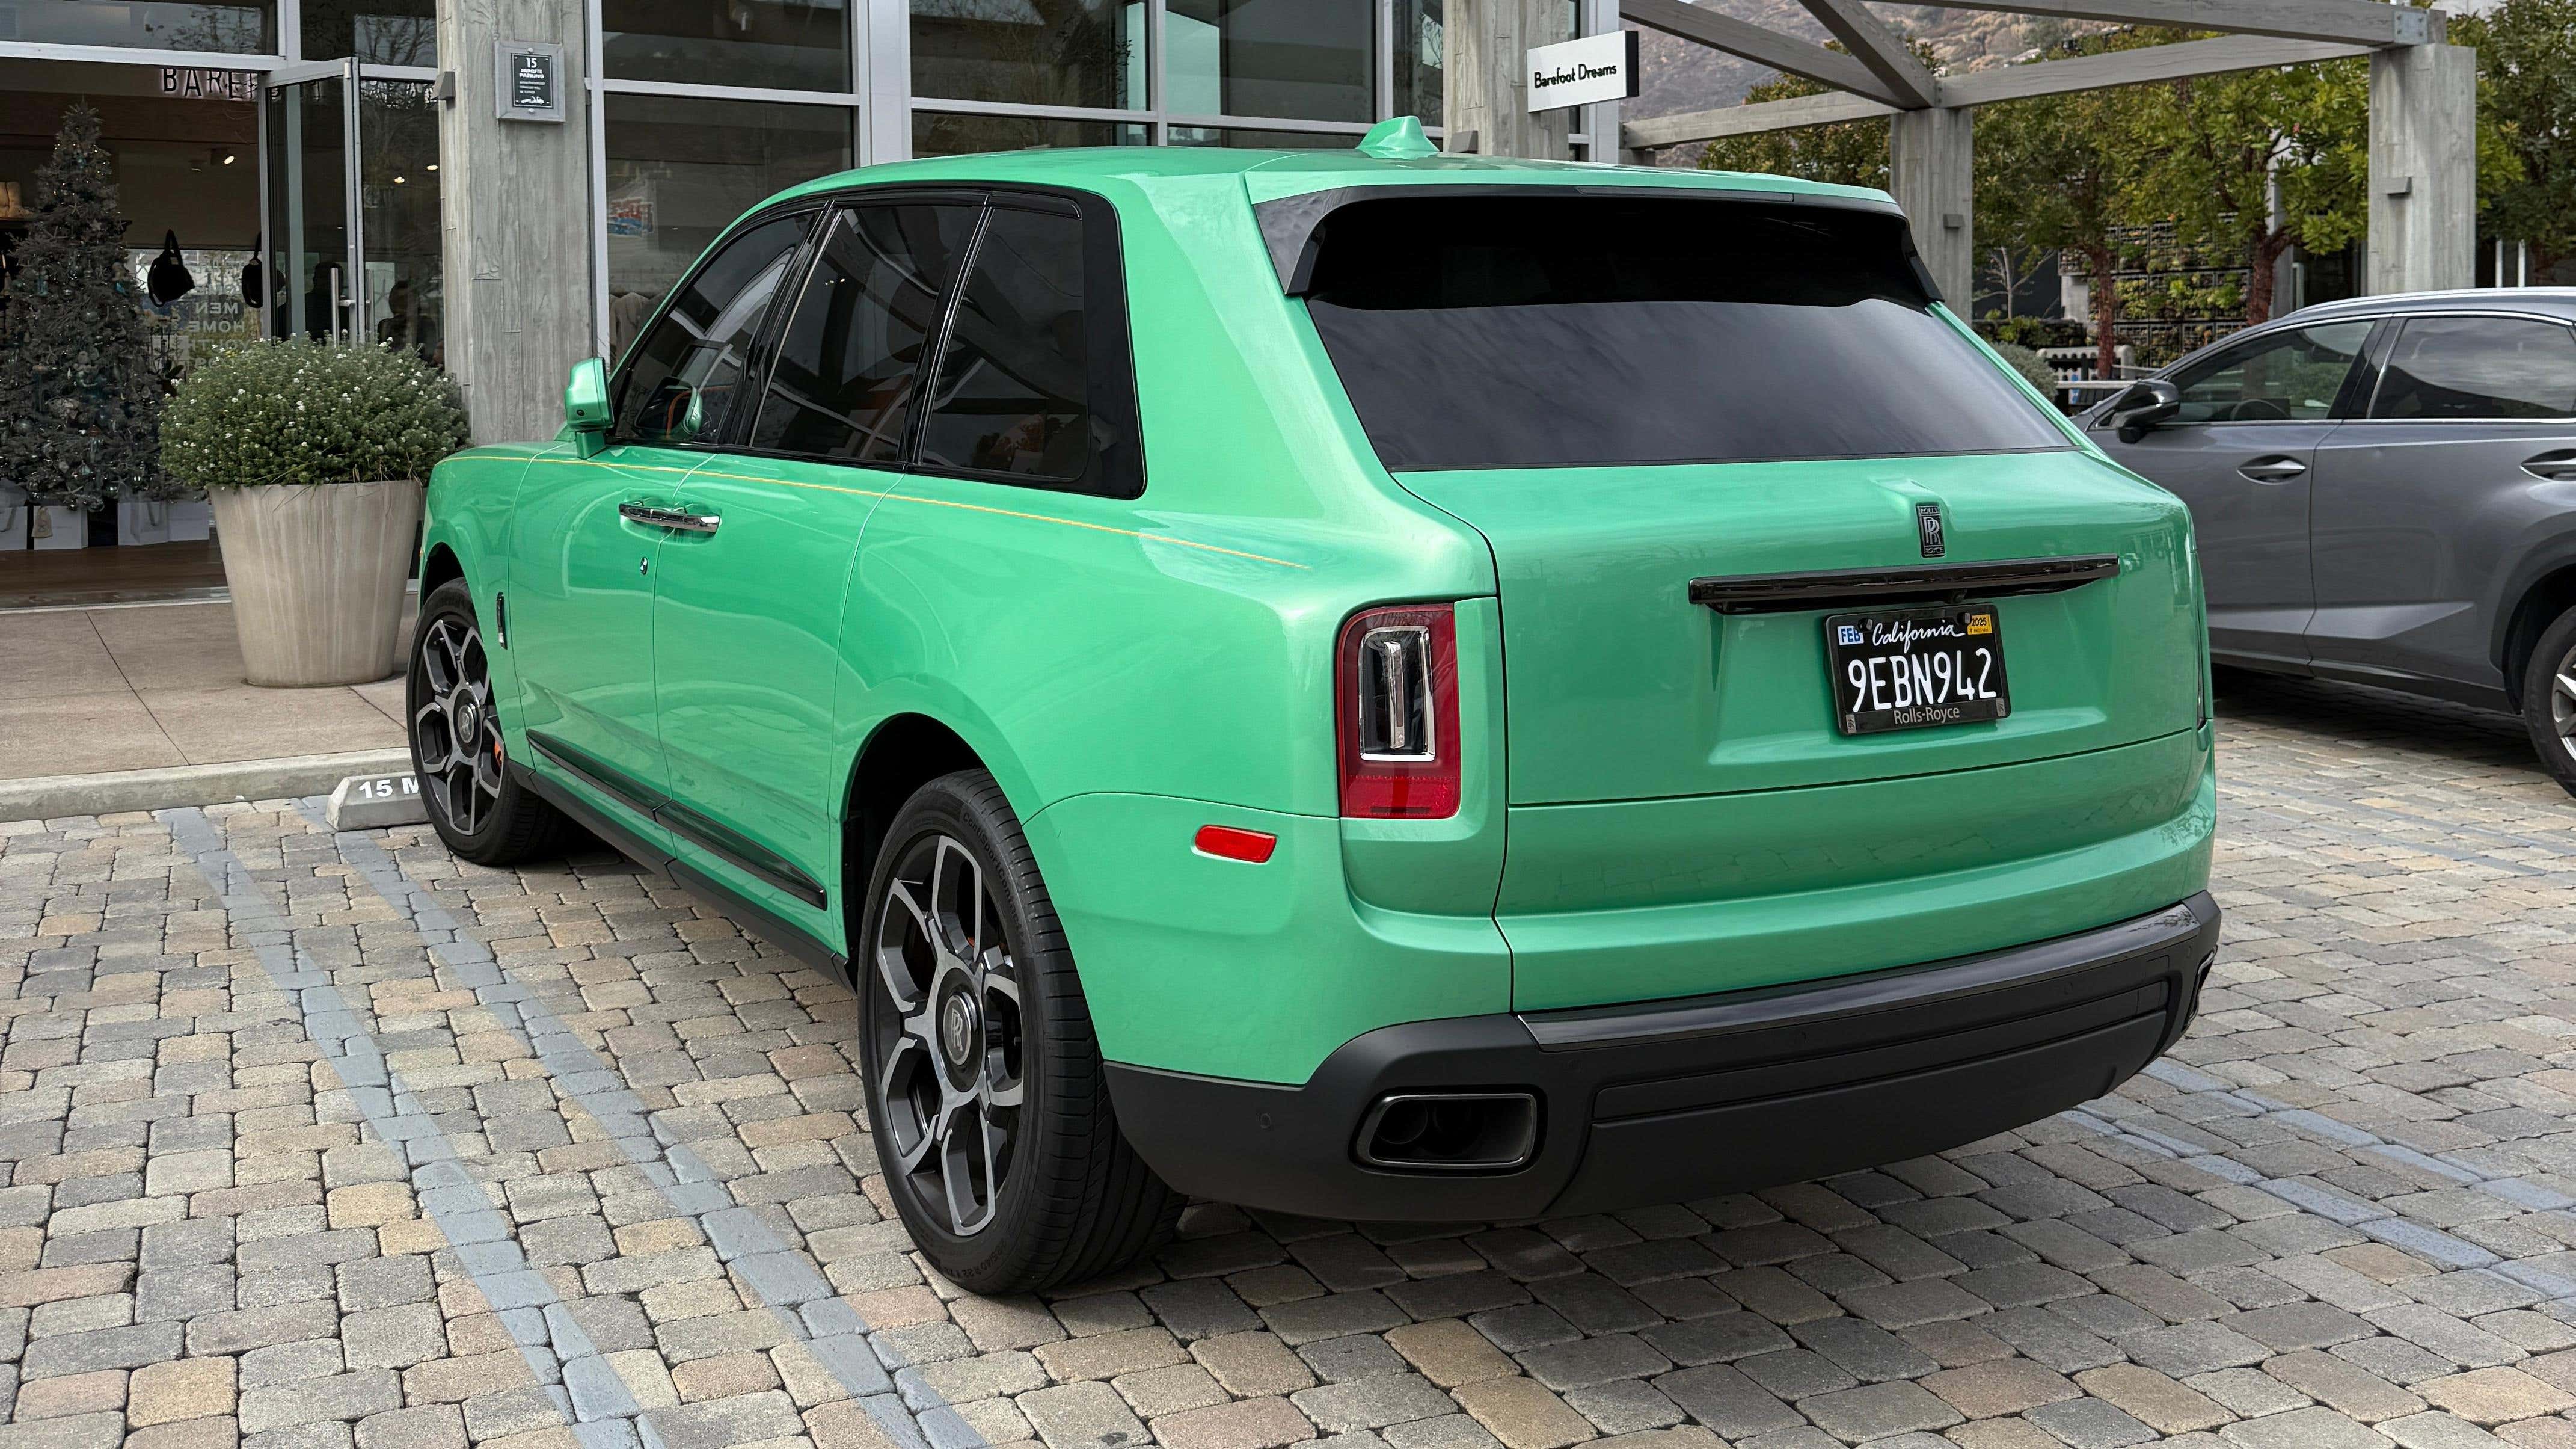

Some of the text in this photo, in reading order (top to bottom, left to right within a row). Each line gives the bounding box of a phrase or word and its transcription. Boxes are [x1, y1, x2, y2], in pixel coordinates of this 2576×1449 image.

[526, 57, 537, 68] 15
[1534, 63, 1617, 88] Barefoot Dreams
[1972, 616, 1987, 626] 2025
[1841, 627, 1862, 643] FEB
[1872, 620, 1966, 654] California
[1848, 647, 1997, 712] 9EBN942
[1894, 706, 1960, 725] Rolls-Royce
[359, 779, 393, 799] 15
